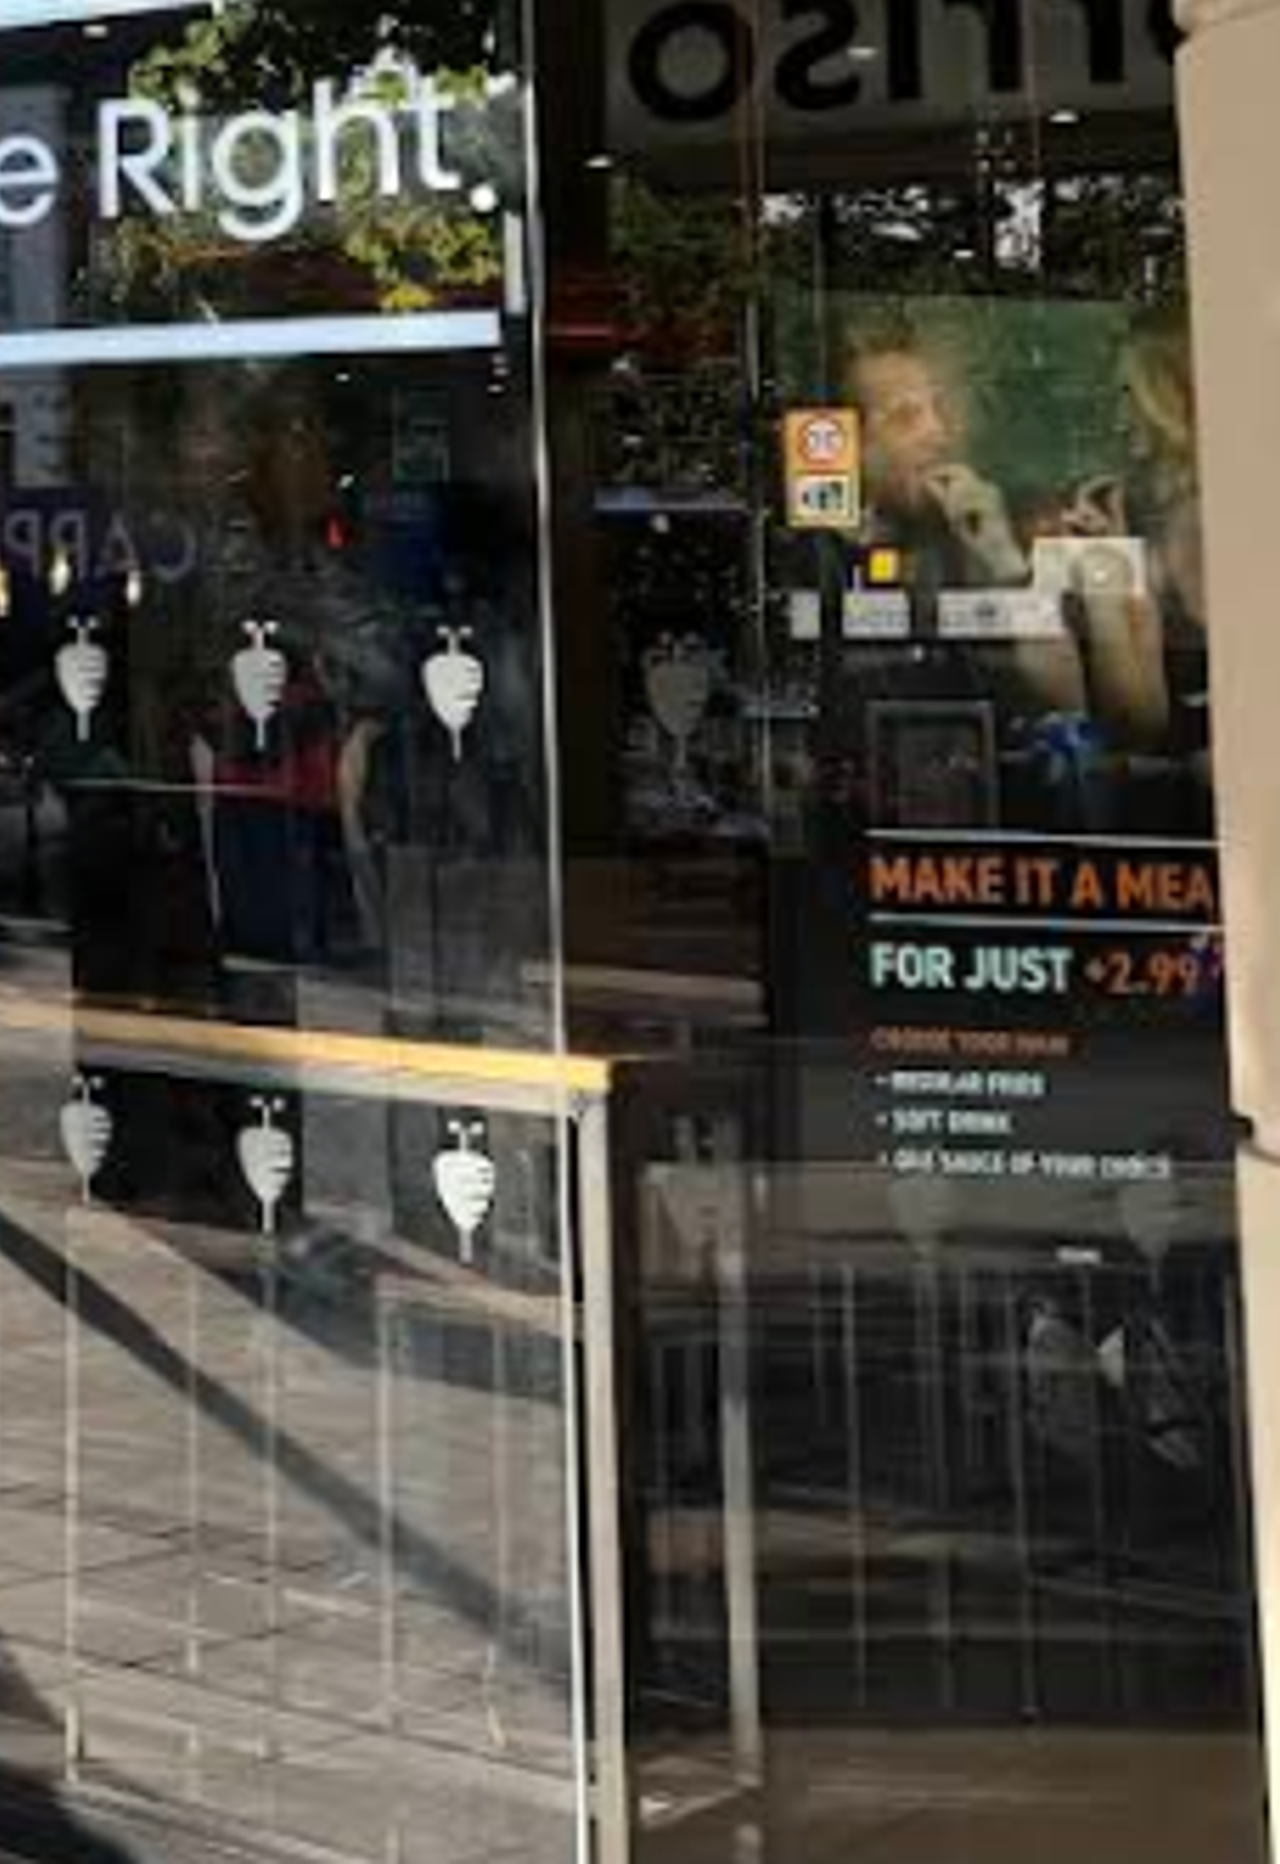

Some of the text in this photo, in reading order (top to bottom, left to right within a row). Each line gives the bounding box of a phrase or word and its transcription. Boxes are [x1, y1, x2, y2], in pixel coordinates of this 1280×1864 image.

[95, 72, 500, 240] Right.
[869, 854, 1006, 905] MAKE
[1015, 857, 1059, 906] IT
[1071, 860, 1104, 908] A
[869, 942, 954, 988] FOR
[964, 945, 1073, 993] JUST
